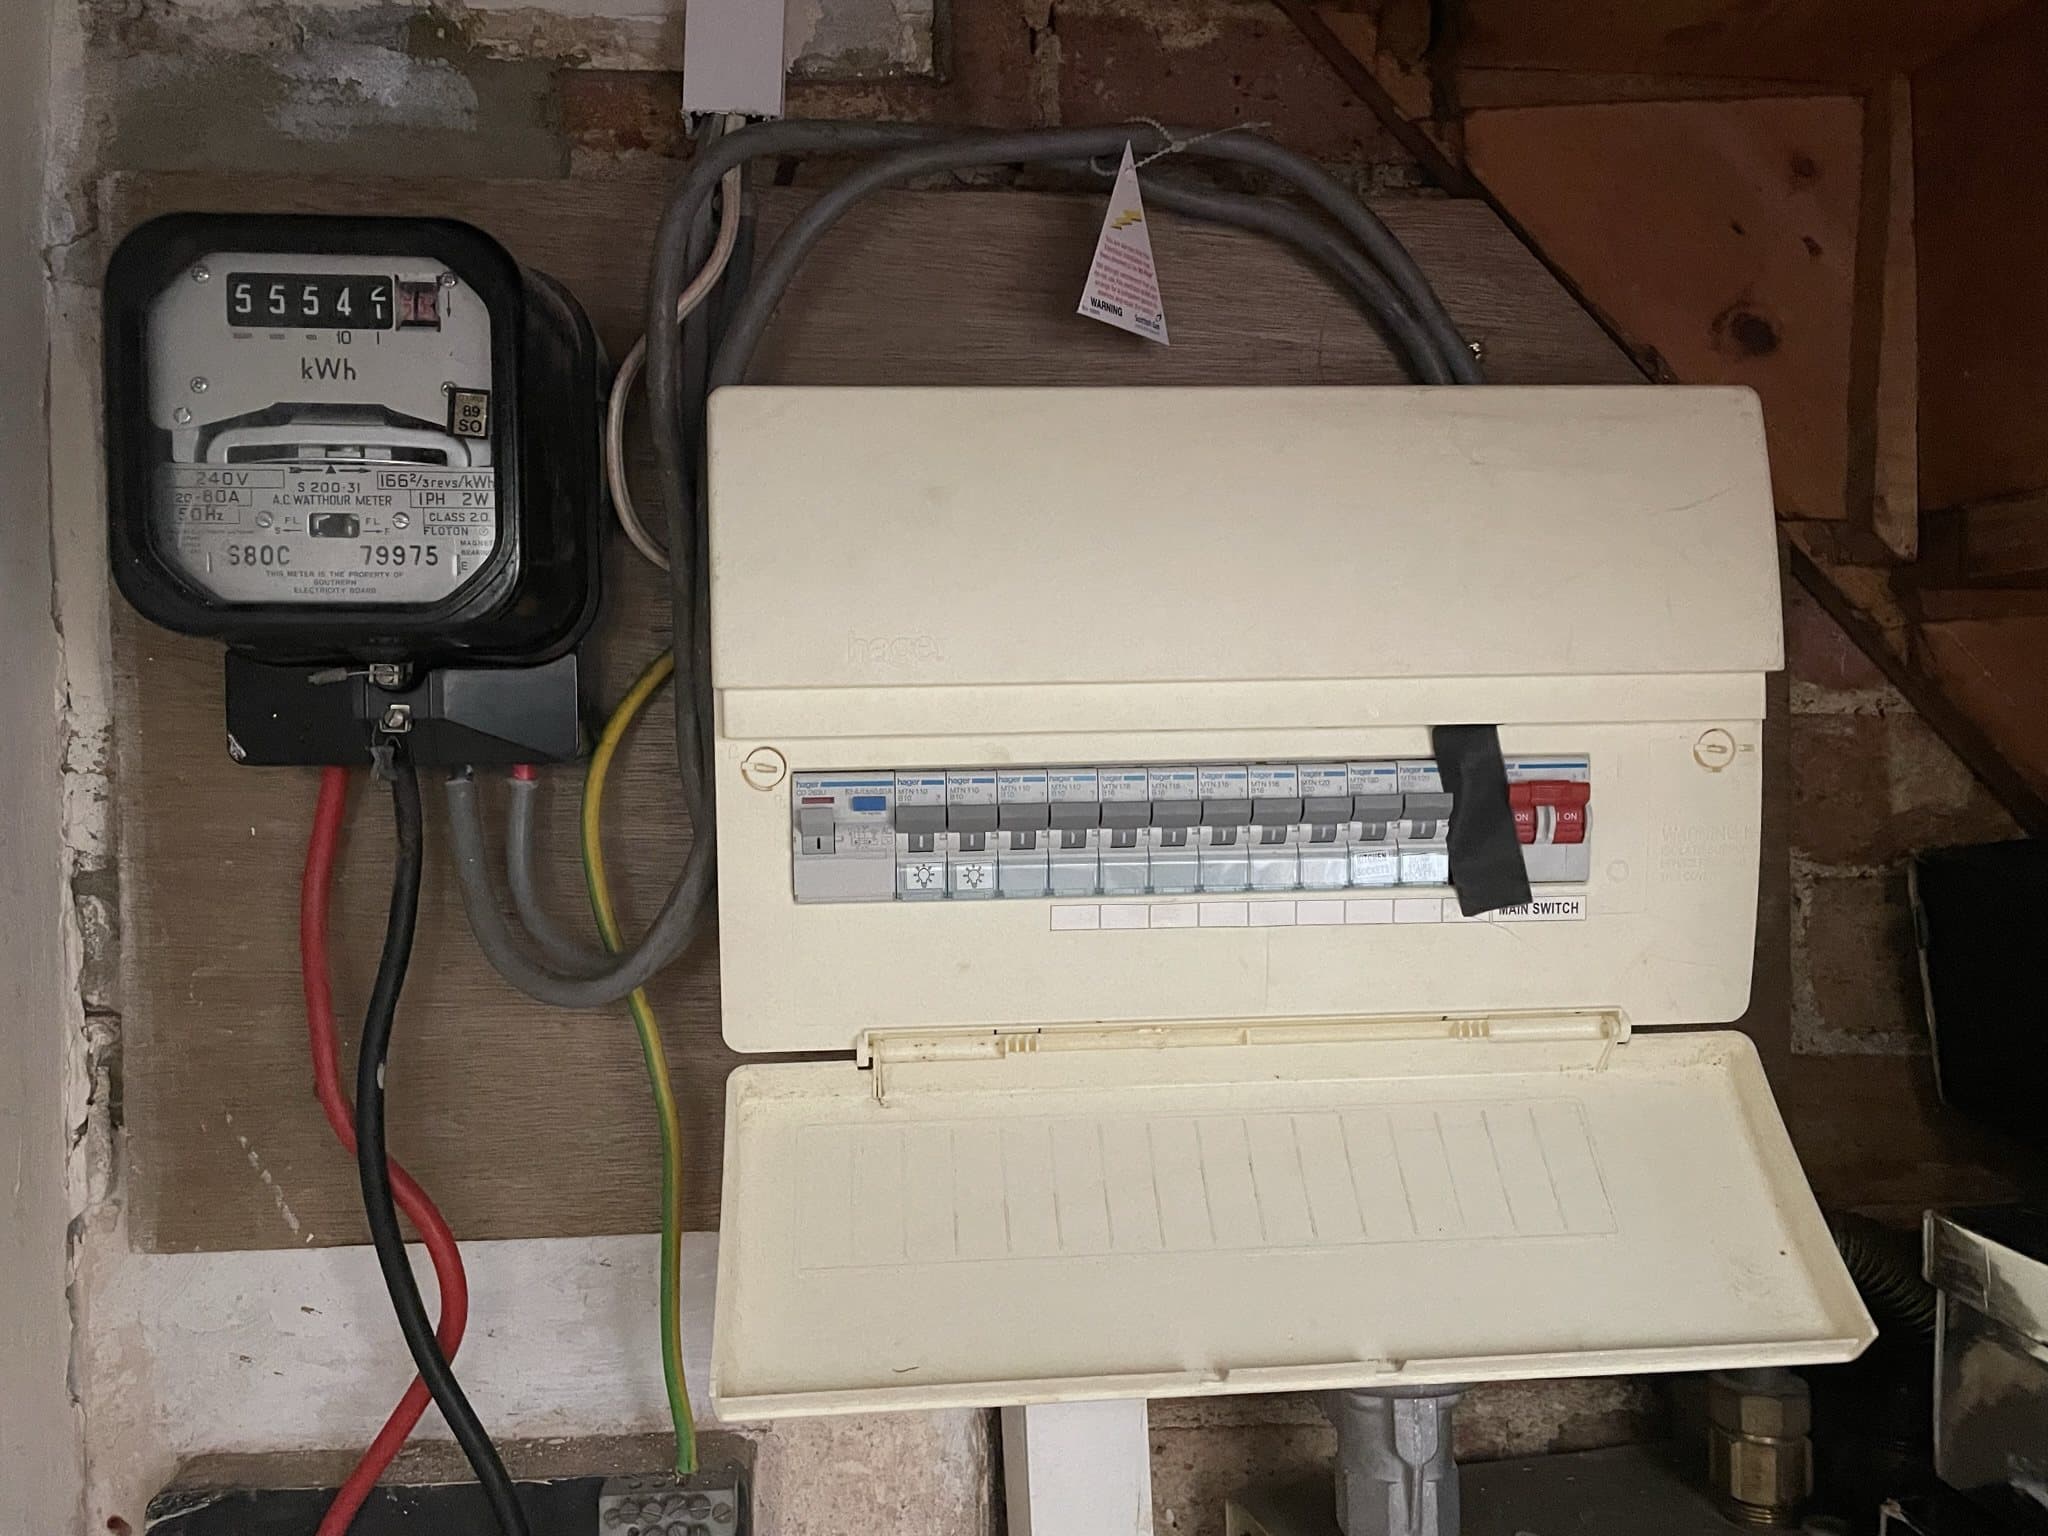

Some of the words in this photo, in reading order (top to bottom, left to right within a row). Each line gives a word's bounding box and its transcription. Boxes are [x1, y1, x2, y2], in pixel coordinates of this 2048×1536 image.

[1090, 296, 1123, 317] WARNING
[300, 356, 357, 381] kWh
[463, 405, 480, 418] 89
[458, 418, 482, 433] SO
[196, 471, 249, 486] 240V
[294, 494, 351, 505] WATTHOUR
[355, 495, 392, 506] METER
[462, 493, 489, 506] 2W
[429, 512, 465, 522] CLASS
[423, 526, 469, 536] FLOTON
[228, 545, 290, 566] S80C
[360, 545, 439, 566] 79975
[330, 570, 344, 578] THE
[1201, 772, 1223, 781] hager
[1250, 771, 1273, 780] hager
[1350, 768, 1373, 776] hager
[897, 778, 920, 786] hager
[948, 776, 971, 785] hager
[998, 775, 1021, 783] hager
[1049, 774, 1071, 782] hager
[1150, 773, 1172, 782] hager
[1515, 813, 1528, 821] ON
[1564, 812, 1578, 821] ON
[1499, 902, 1528, 915] MAIN
[1532, 901, 1579, 915] SWITCH
